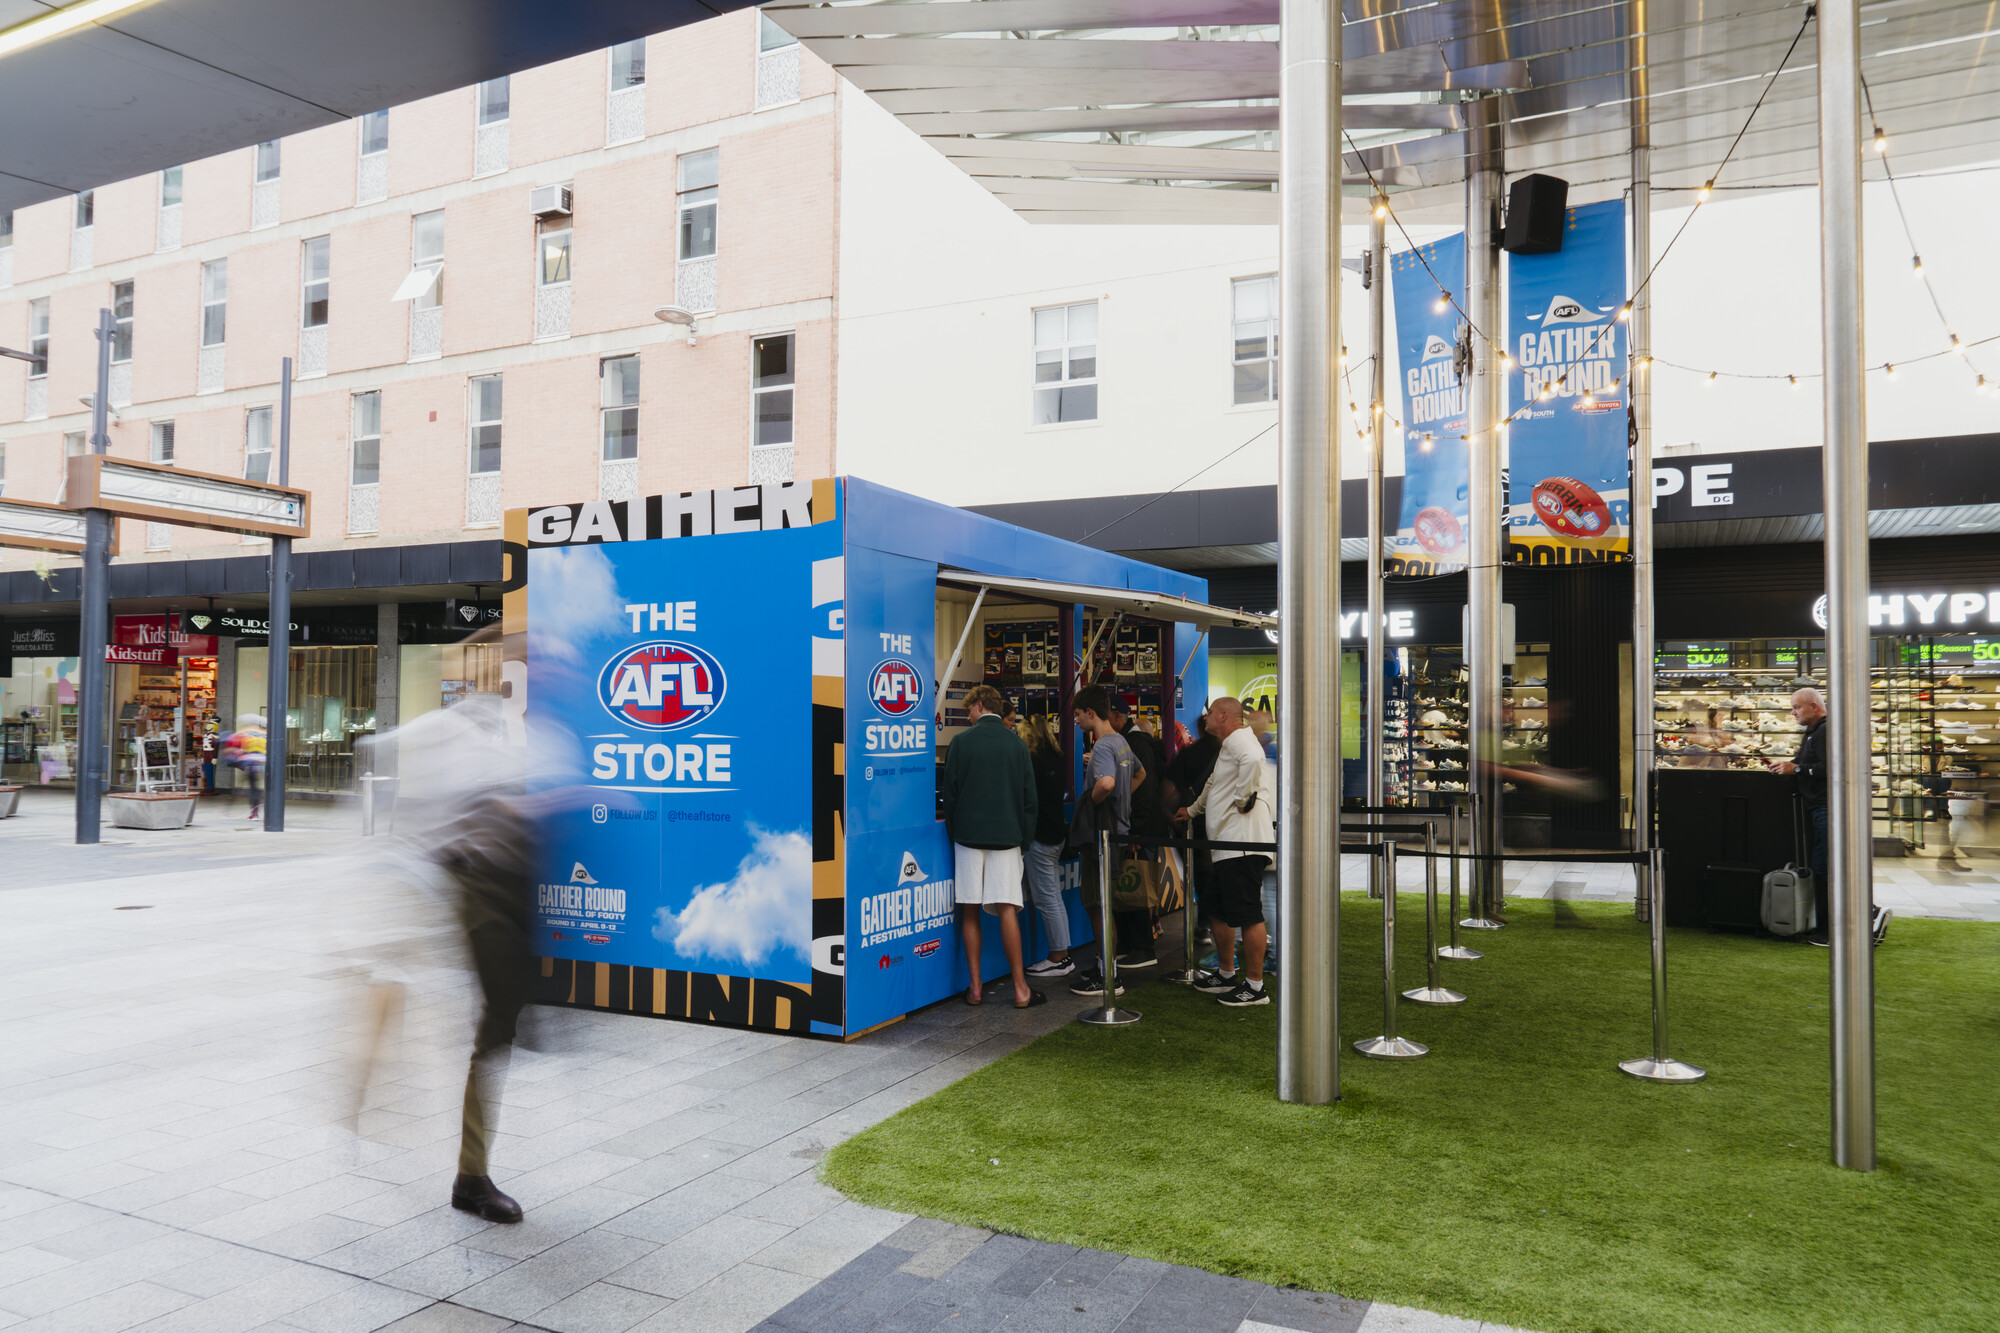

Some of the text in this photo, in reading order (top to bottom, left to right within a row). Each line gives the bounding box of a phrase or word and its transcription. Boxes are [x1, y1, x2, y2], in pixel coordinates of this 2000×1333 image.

[1555, 307, 1579, 316] AFL
[1430, 345, 1446, 353] AFL
[1519, 324, 1615, 367] GATHER
[1407, 359, 1468, 397] GATH
[1523, 360, 1611, 401] ROUND
[1412, 386, 1467, 425] ROUND
[1534, 481, 1585, 518] HERRIN
[1652, 463, 1734, 509] PE
[528, 481, 812, 544] GATHER
[1509, 499, 1629, 527] GAR
[1538, 495, 1559, 514] AFL
[221, 617, 298, 631] SOLID GD
[625, 601, 696, 633] THE
[1340, 611, 1414, 639] YE
[11, 630, 29, 643] Just
[880, 633, 911, 655] THE
[105, 645, 165, 662] Kidstuff
[1776, 654, 1795, 662] Sale
[609, 663, 714, 706] AFL
[873, 673, 919, 702] AFL
[1242, 695, 1278, 724] SA
[865, 725, 926, 750] STORE
[592, 744, 731, 782] STORE
[610, 809, 731, 823] FOLLOW US! @theaflstore
[905, 865, 916, 874] AFL
[537, 884, 626, 913] GATHER ROUND
[861, 879, 954, 936] GATHER ROUND
[545, 908, 583, 917] FESTIVAL
[585, 910, 596, 918] OF
[598, 912, 626, 920] FOOTY
[861, 914, 955, 949] A FESTIVAL OF FOOTY
[927, 941, 940, 949] TOYOTA
